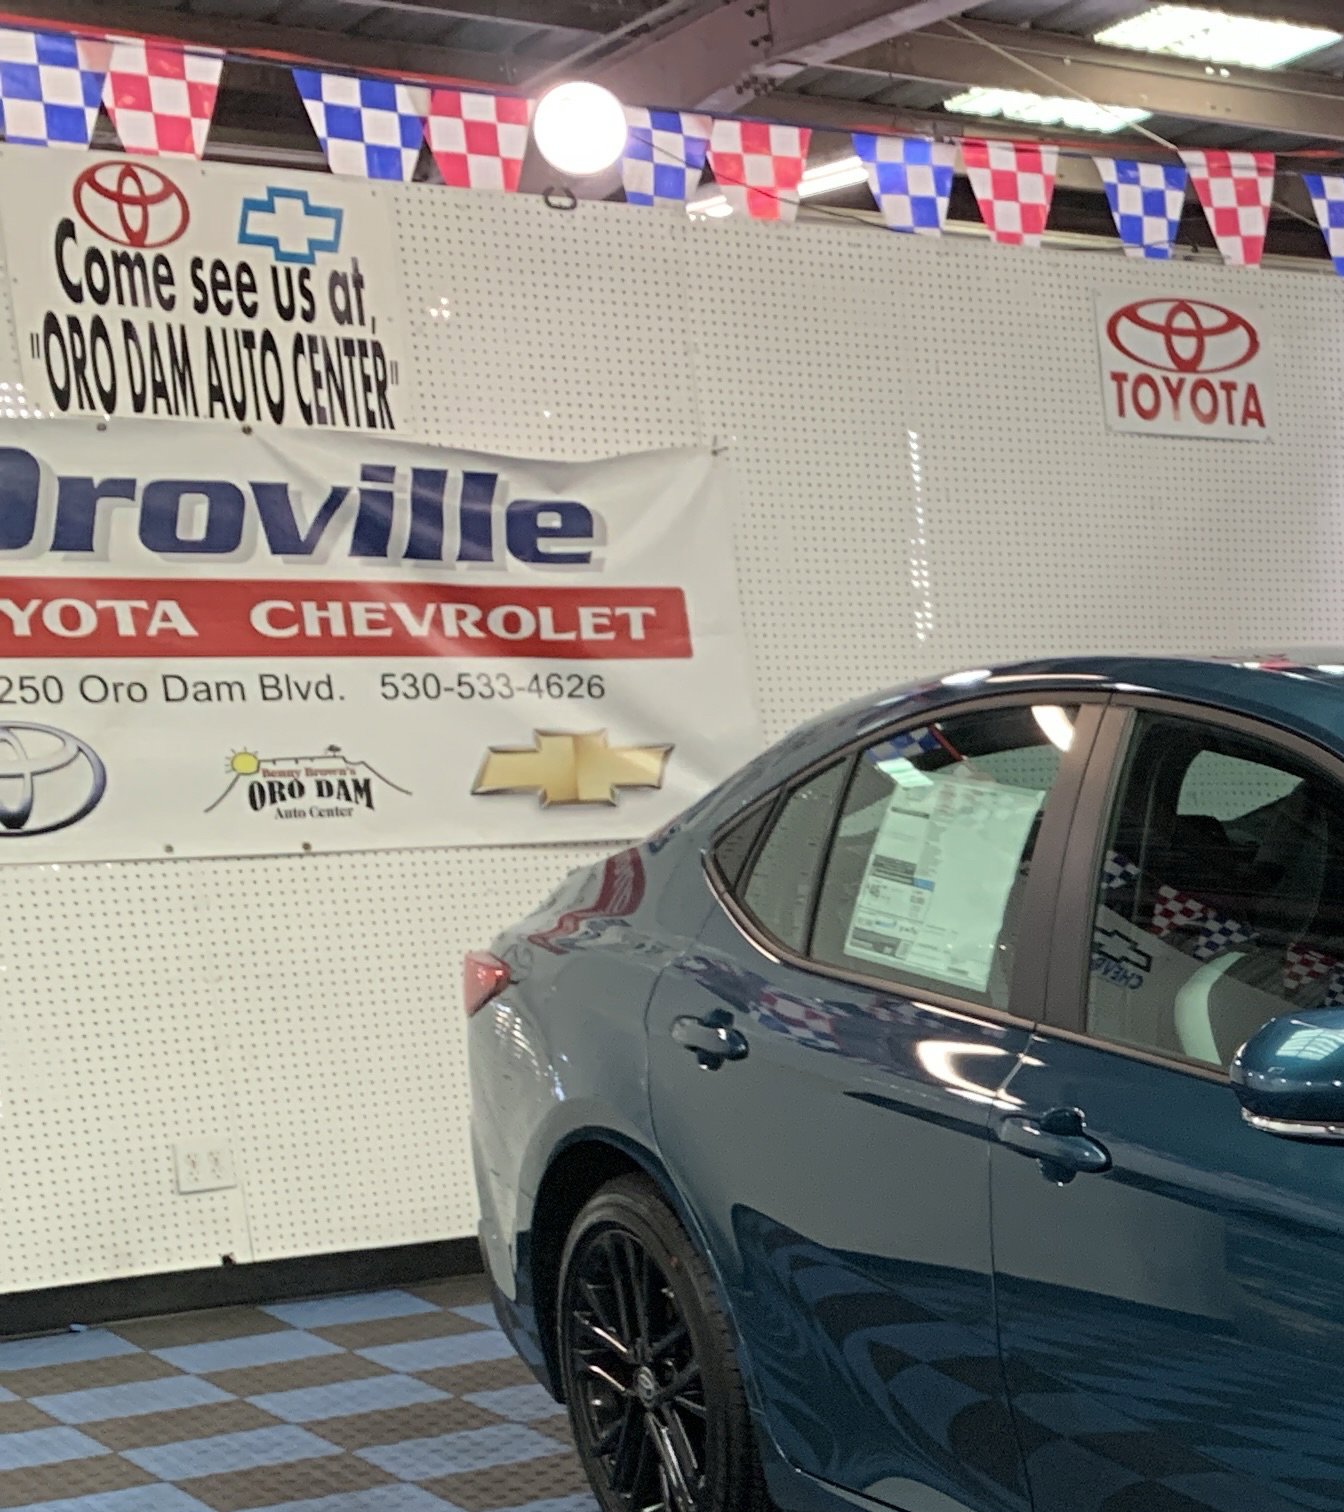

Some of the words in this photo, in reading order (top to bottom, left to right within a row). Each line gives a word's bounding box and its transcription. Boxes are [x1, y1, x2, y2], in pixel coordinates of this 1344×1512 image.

[54, 218, 176, 312] Come
[191, 256, 258, 318] see
[270, 264, 316, 323] us
[121, 318, 200, 417] DAM
[205, 325, 285, 425] AUTO
[1110, 371, 1266, 428] TOYOTA
[0, 598, 199, 638] YOTA
[250, 599, 656, 641] CHEVROLET
[79, 674, 147, 703] Oro
[162, 673, 246, 702] Dam
[259, 672, 345, 702] Blvd.
[380, 672, 606, 700] 530-533-4626
[248, 779, 305, 812] ORO
[314, 778, 375, 811] DAM
[275, 807, 307, 820] Auto
[309, 805, 354, 819] Center
